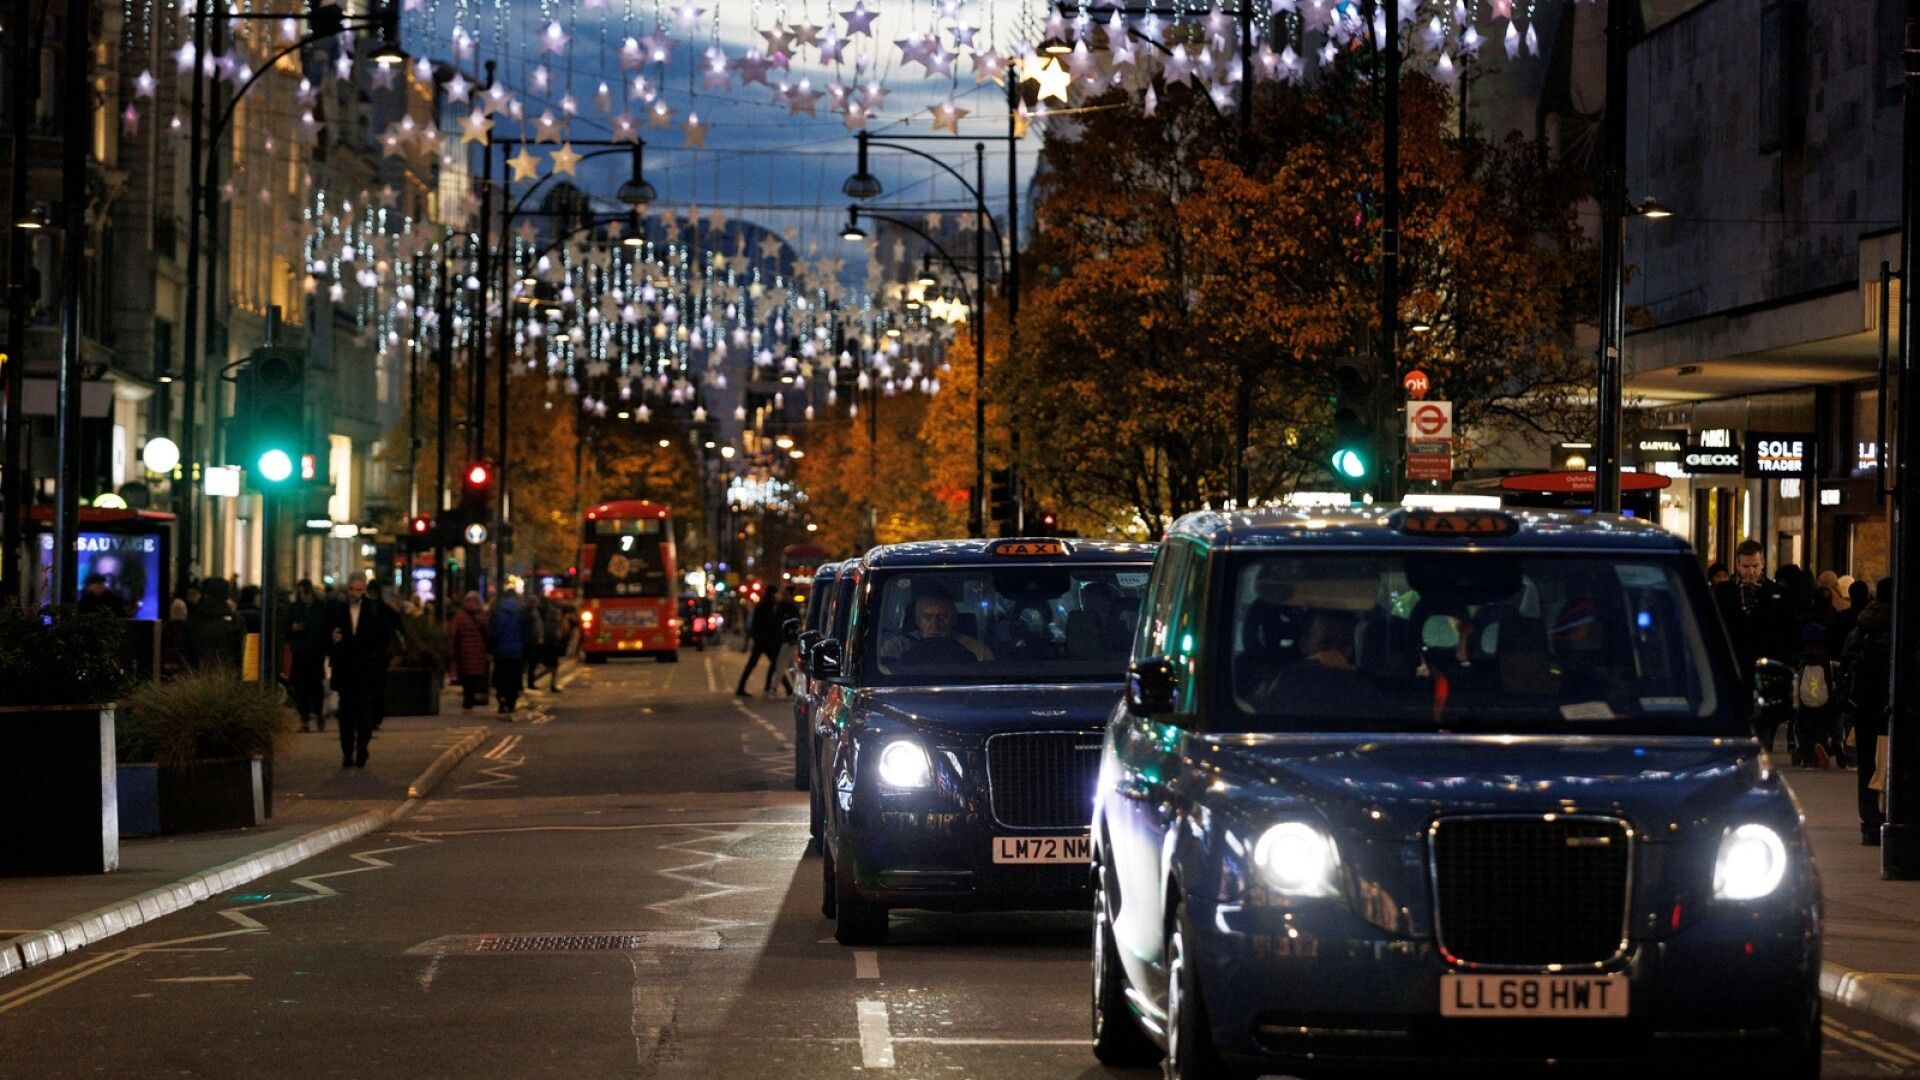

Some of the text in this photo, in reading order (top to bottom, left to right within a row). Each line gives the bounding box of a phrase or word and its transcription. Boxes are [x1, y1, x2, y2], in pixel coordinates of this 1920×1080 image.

[1757, 440, 1803, 458] SOLE
[1685, 453, 1739, 466] GEOX
[1757, 459, 1803, 471] TRADER
[1566, 475, 1588, 483] Oxford
[77, 536, 155, 553] SAUVAGE
[620, 535, 634, 551] 7
[1001, 543, 1059, 554] TAXI
[1001, 838, 1090, 859] LM72 NM
[1455, 979, 1614, 1009] LL68 HWT
